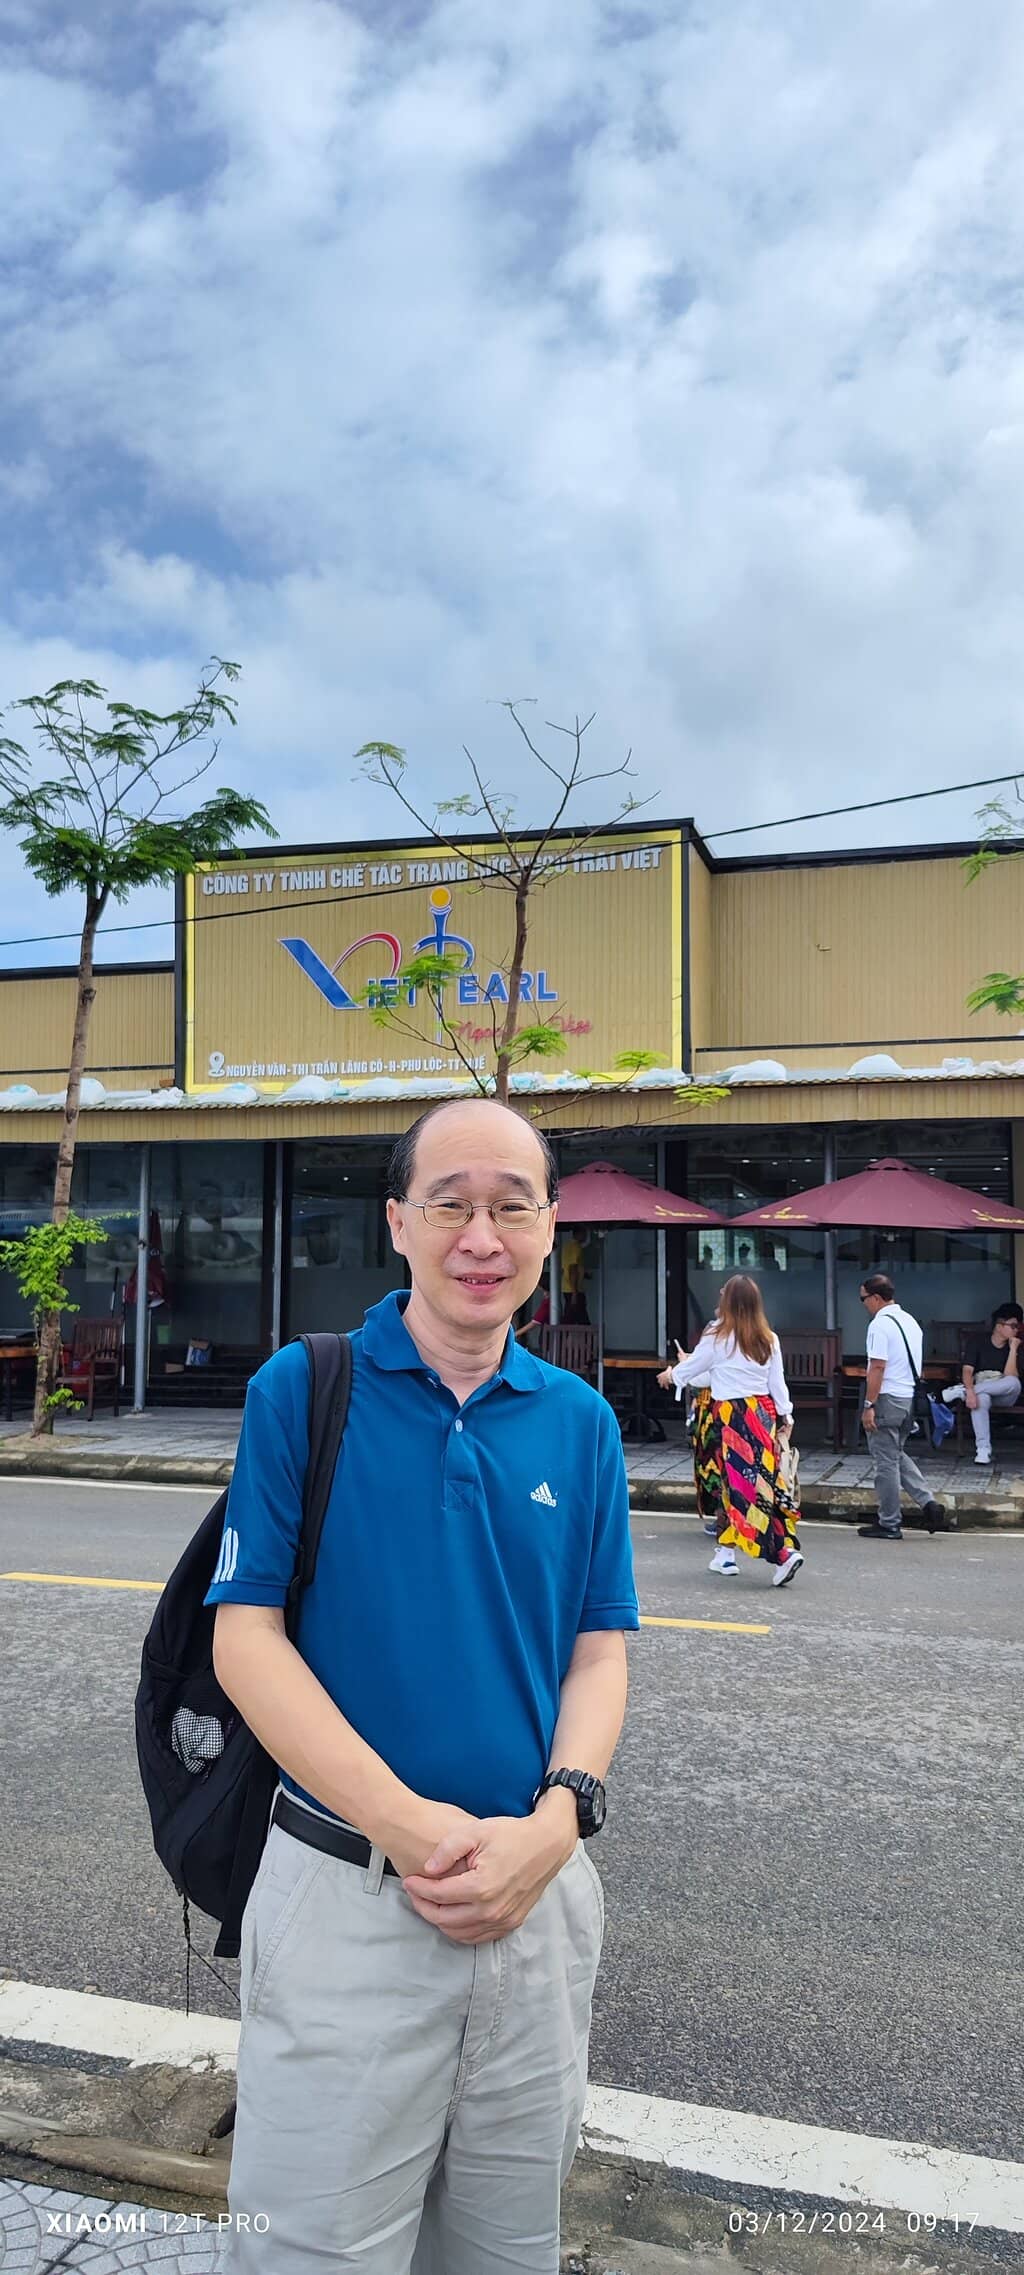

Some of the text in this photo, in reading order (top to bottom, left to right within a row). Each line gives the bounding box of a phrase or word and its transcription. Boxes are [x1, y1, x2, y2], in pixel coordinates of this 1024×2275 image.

[203, 872, 249, 895] CÔNG
[253, 873, 275, 893] TY
[280, 869, 327, 891] TNHH
[330, 863, 368, 888] CHẾ
[369, 863, 402, 886] TÁC
[408, 861, 468, 883] TRANG
[622, 843, 662, 871] VIỆT
[530, 1491, 557, 1508] adidas
